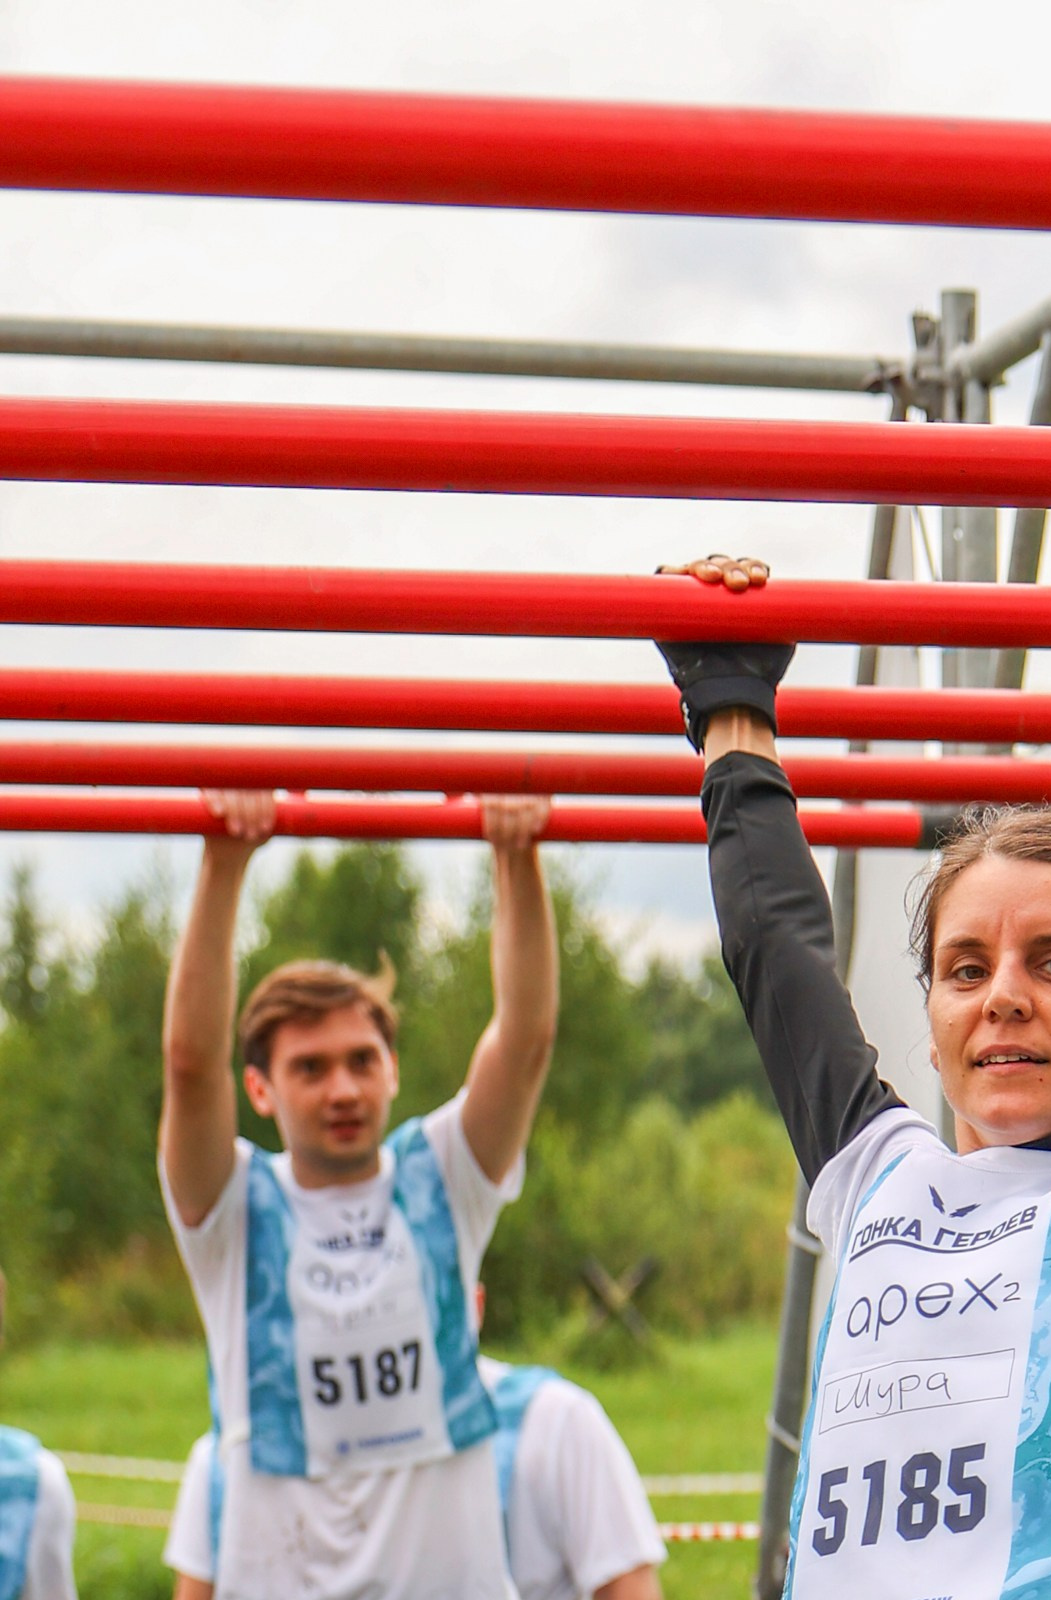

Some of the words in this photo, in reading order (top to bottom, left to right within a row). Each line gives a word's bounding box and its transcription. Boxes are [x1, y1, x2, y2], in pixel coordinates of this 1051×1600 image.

[851, 1217, 922, 1254] ГОНКА
[933, 1205, 1038, 1248] ГЕРОЕВ
[311, 1338, 422, 1407] 5187
[812, 1442, 987, 1557] 5185
